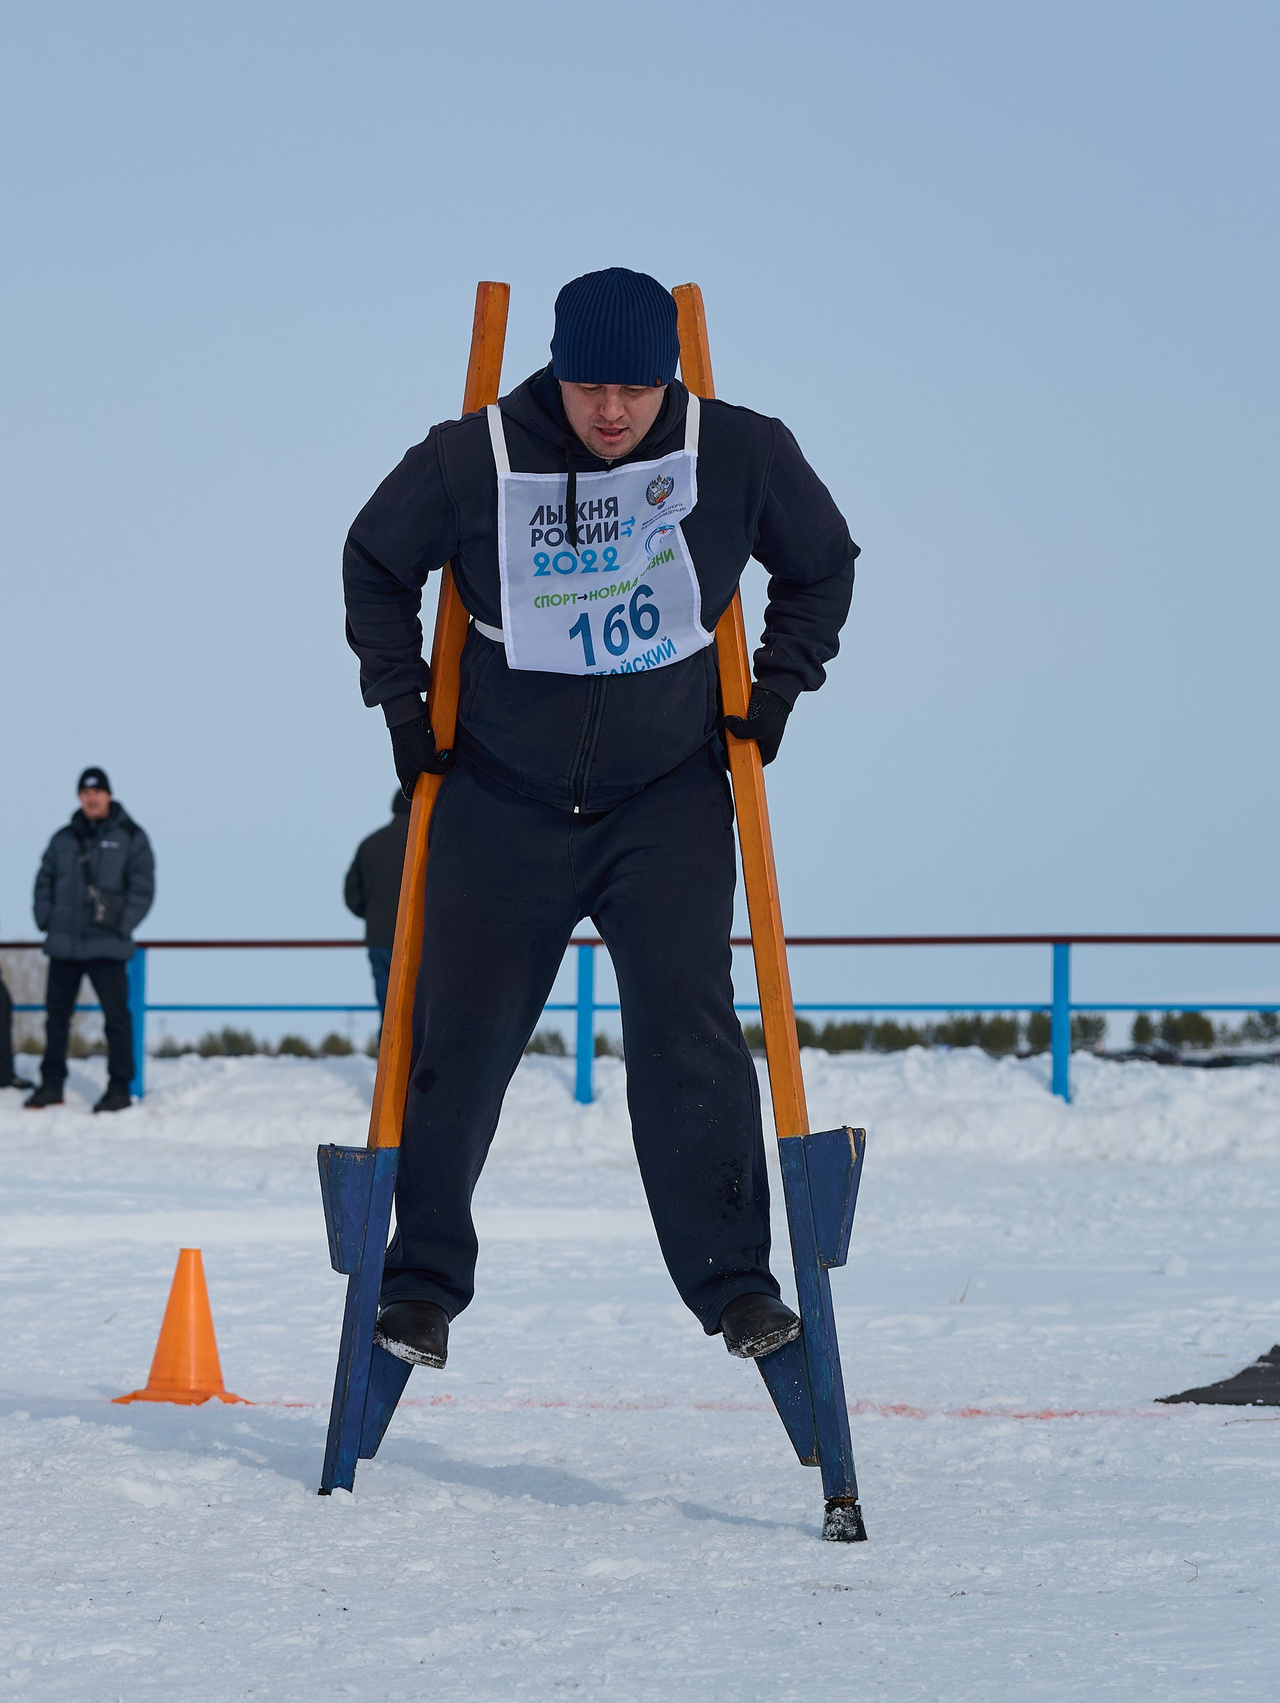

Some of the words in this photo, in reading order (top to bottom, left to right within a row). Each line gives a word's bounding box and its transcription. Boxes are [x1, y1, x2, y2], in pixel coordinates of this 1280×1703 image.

[533, 546, 620, 577] 2022
[533, 593, 578, 609] СПОРТ
[589, 577, 639, 601] НОРМА
[568, 584, 661, 667] 166
